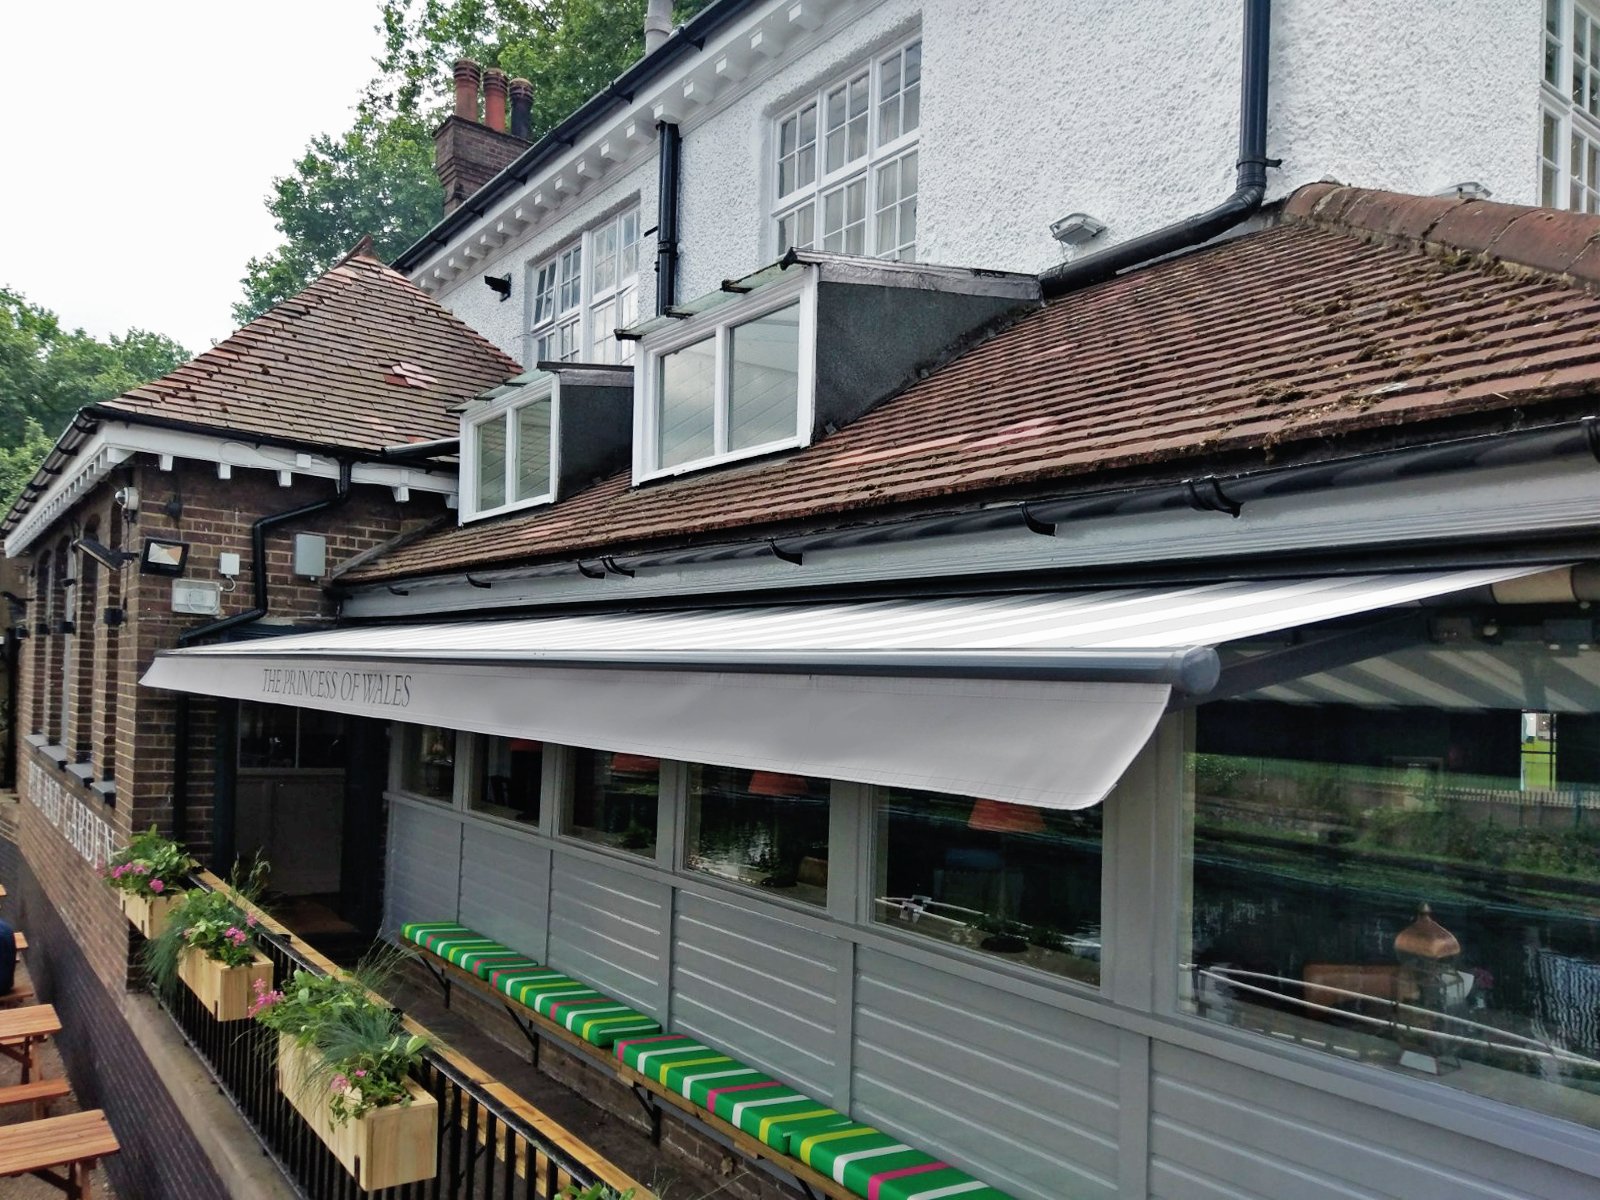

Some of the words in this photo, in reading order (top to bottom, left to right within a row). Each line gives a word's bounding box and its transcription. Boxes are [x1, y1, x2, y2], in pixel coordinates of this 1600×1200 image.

[262, 668, 282, 693] THE
[282, 669, 338, 700] PRINCESS
[340, 671, 361, 701] OF
[362, 673, 412, 707] WALES
[64, 792, 115, 869] GARDEN
